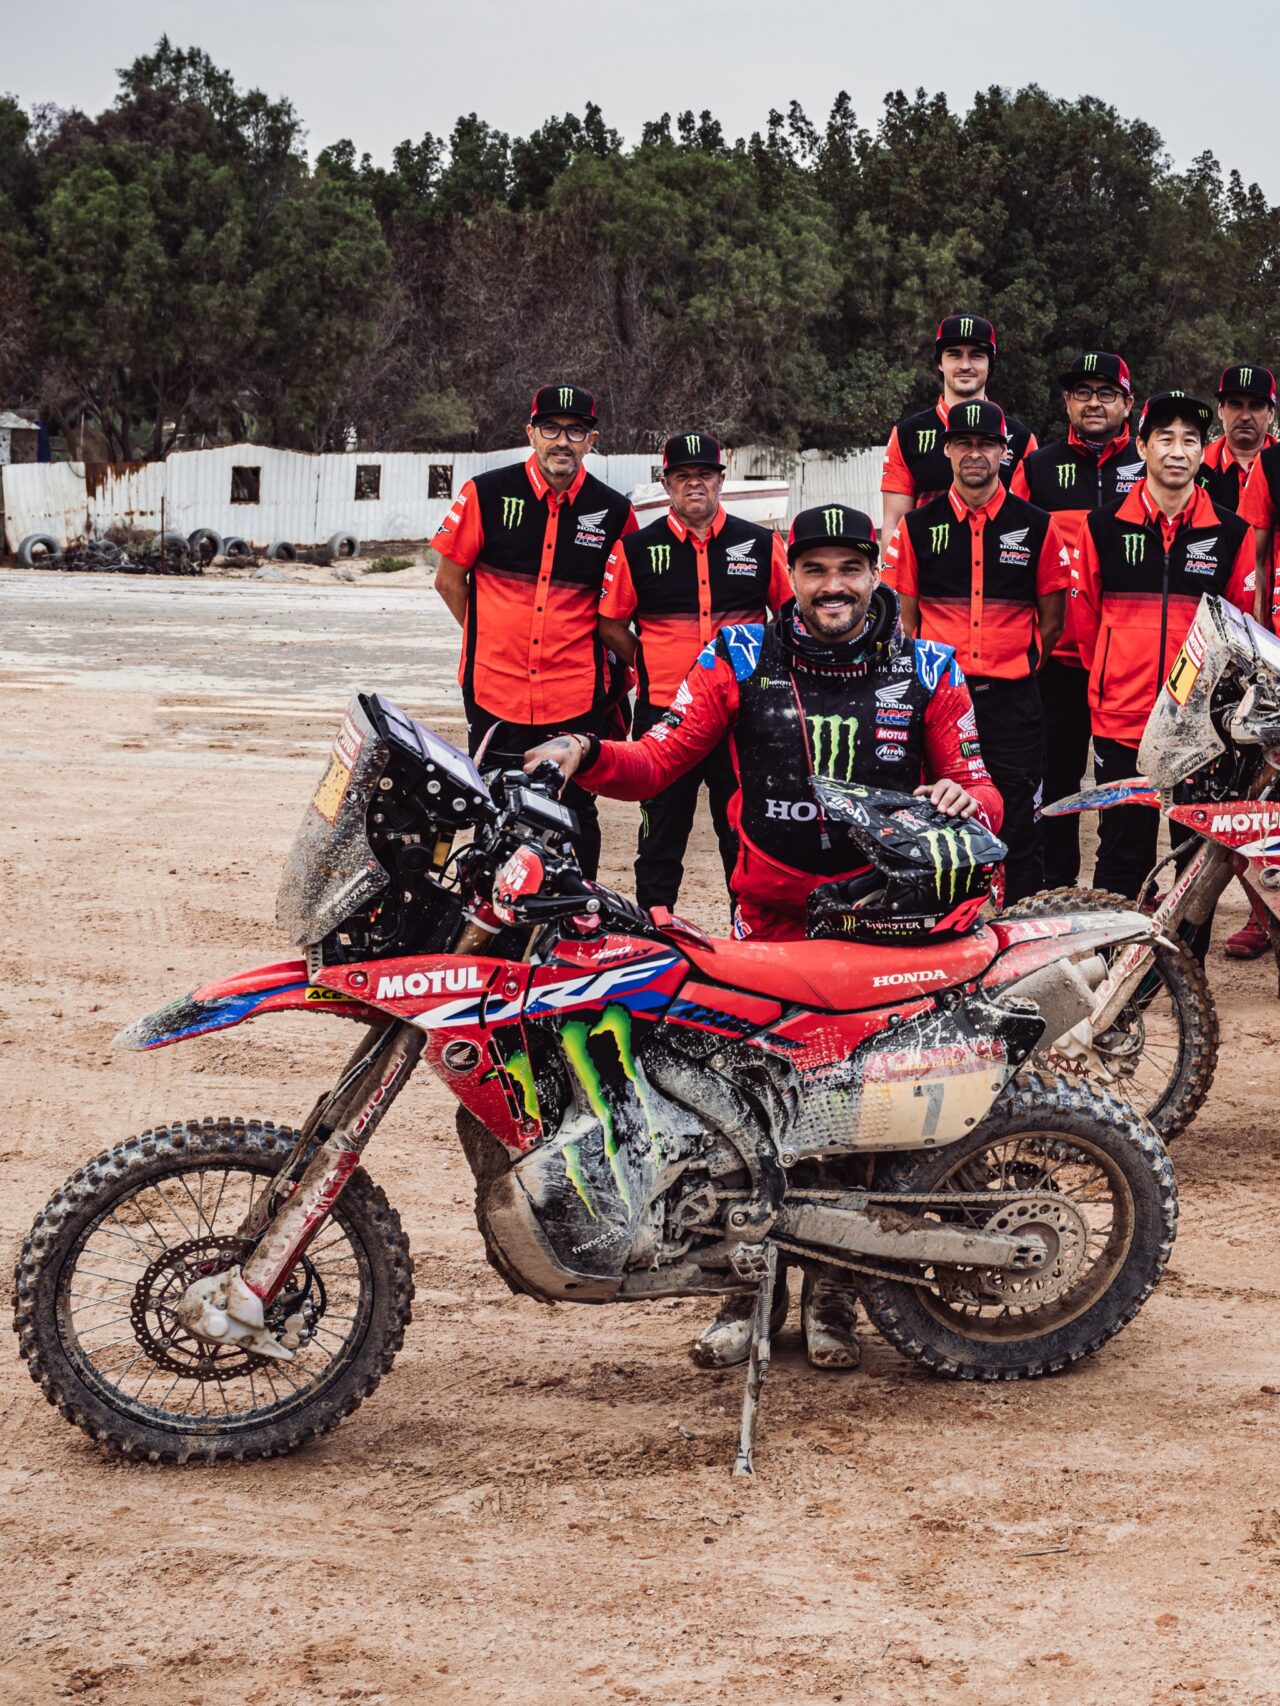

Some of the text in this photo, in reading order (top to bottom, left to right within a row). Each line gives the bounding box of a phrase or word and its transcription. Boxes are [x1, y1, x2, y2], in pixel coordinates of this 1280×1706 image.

[577, 525, 606, 535] HONDA
[1000, 543, 1031, 553] HONDA
[727, 556, 757, 564] HONDA
[1186, 553, 1218, 561] HONDA
[891, 663, 913, 673] BAG
[876, 701, 914, 710] HONDA
[875, 709, 913, 722] HRC
[878, 728, 908, 740] MOTUL
[865, 921, 921, 930] MONSTER
[872, 968, 947, 988] HONDA
[376, 967, 484, 1000] MOTUL
[411, 956, 677, 1029] CRF
